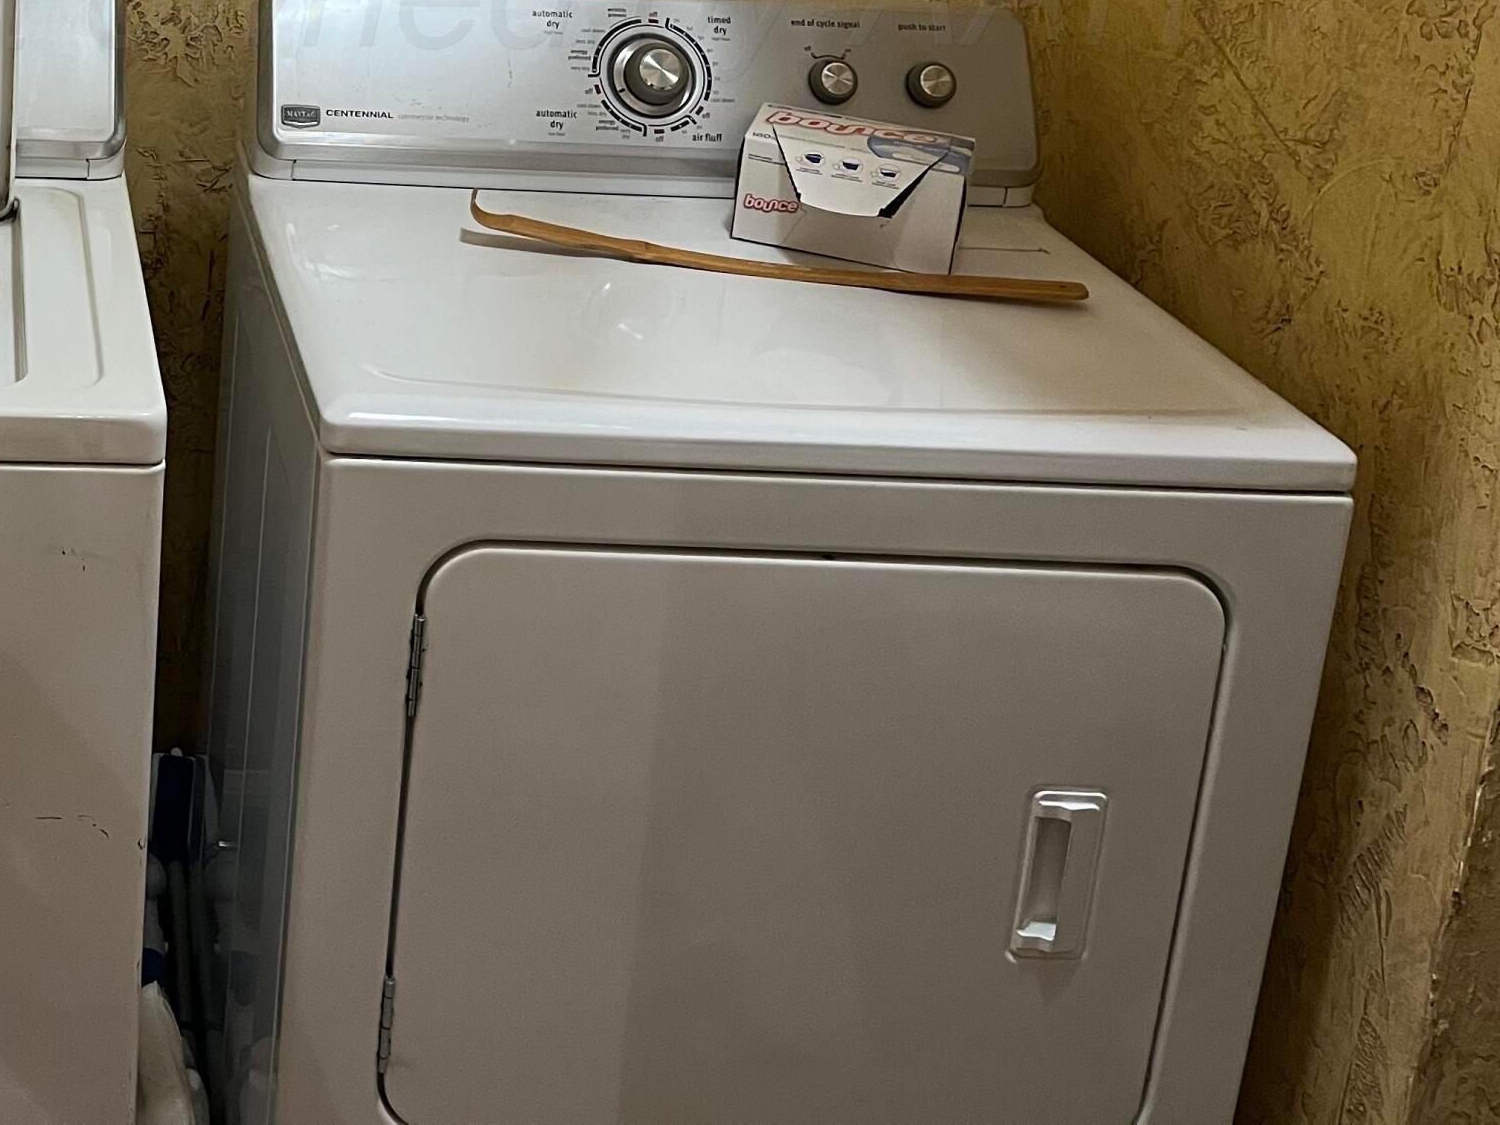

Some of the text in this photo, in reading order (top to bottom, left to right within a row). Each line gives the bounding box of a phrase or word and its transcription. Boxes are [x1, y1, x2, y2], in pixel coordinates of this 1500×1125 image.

[532, 10, 573, 18] automatic
[546, 20, 560, 29] dry
[708, 16, 731, 24] timed
[816, 20, 835, 28] cycle
[837, 20, 860, 29] signal
[713, 26, 727, 35] dry
[326, 109, 393, 119] CENTENNIAL
[536, 110, 577, 118] automatic
[550, 120, 564, 130] dry
[692, 133, 722, 142] air fluff
[743, 193, 800, 214] bounce
